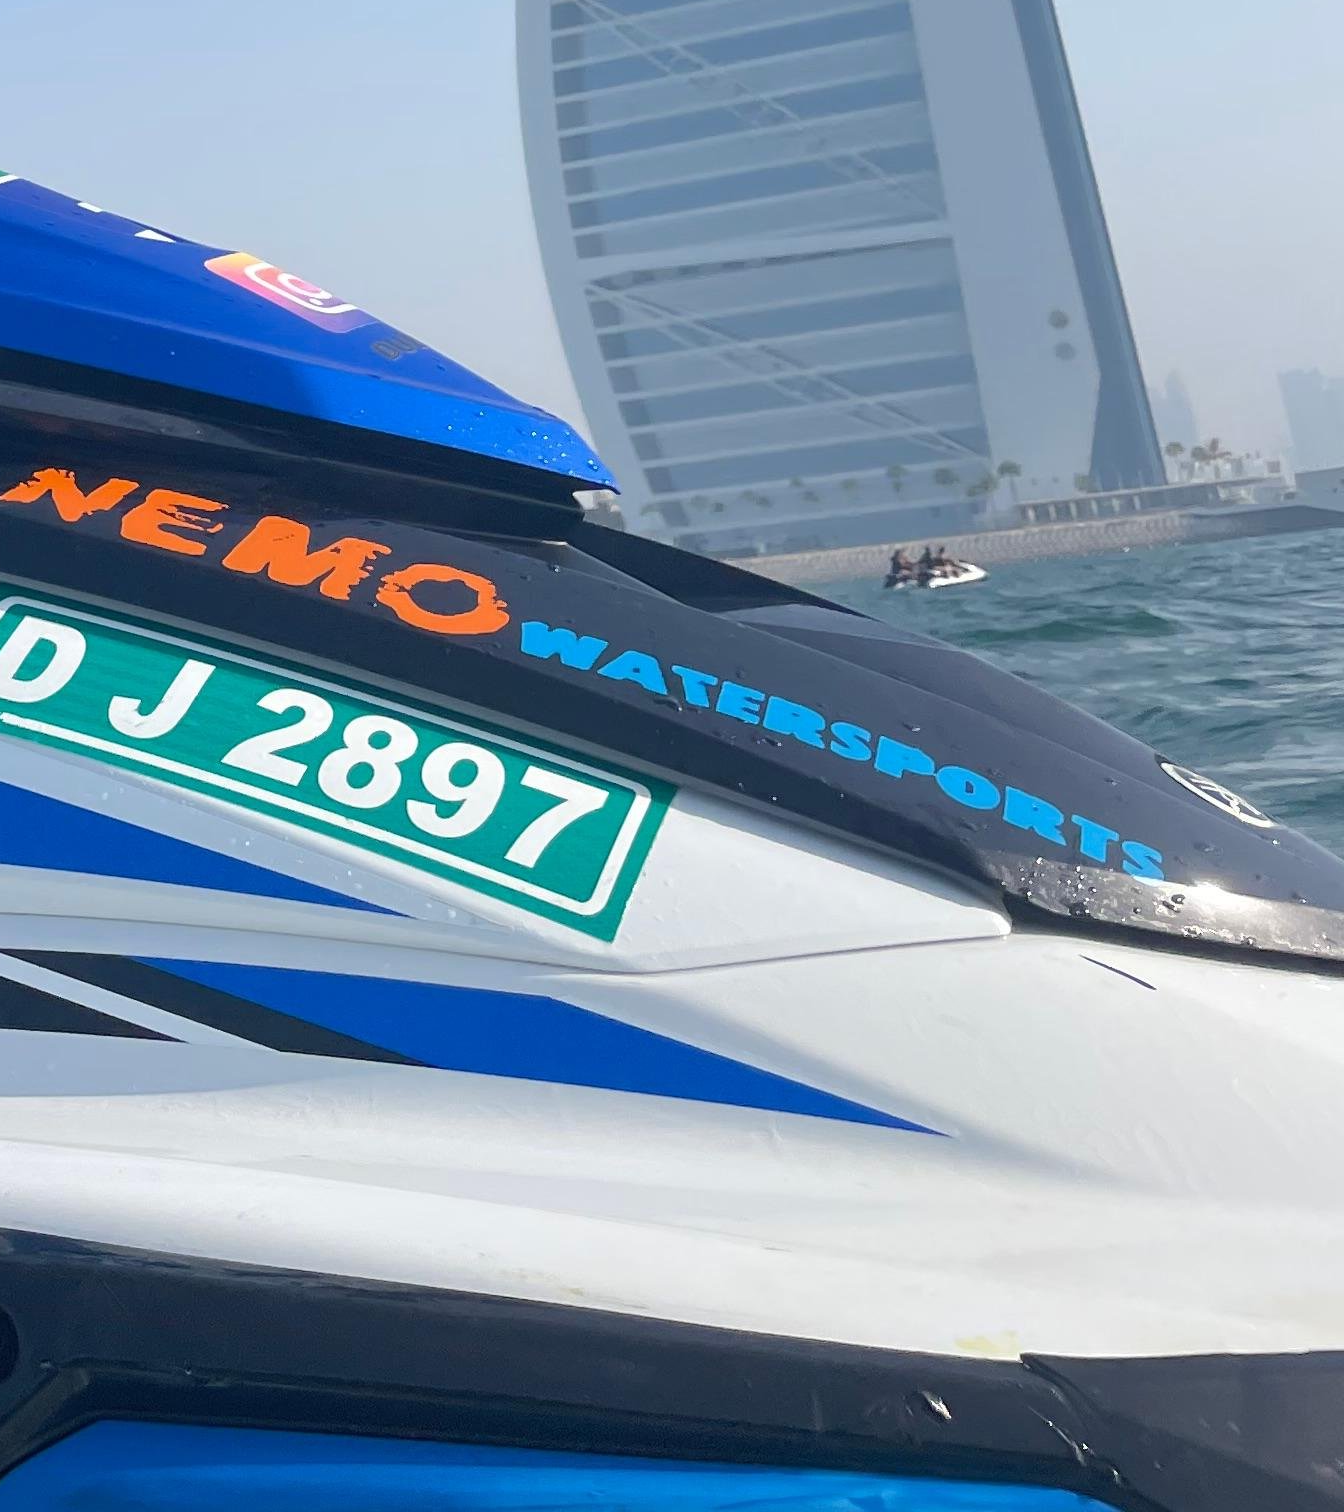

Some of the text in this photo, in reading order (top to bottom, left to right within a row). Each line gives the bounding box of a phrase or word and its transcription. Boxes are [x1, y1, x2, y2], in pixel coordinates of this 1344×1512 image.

[108, 659, 216, 740] J
[221, 688, 610, 869] 2897
[520, 620, 1165, 885] WATERSPORTS
